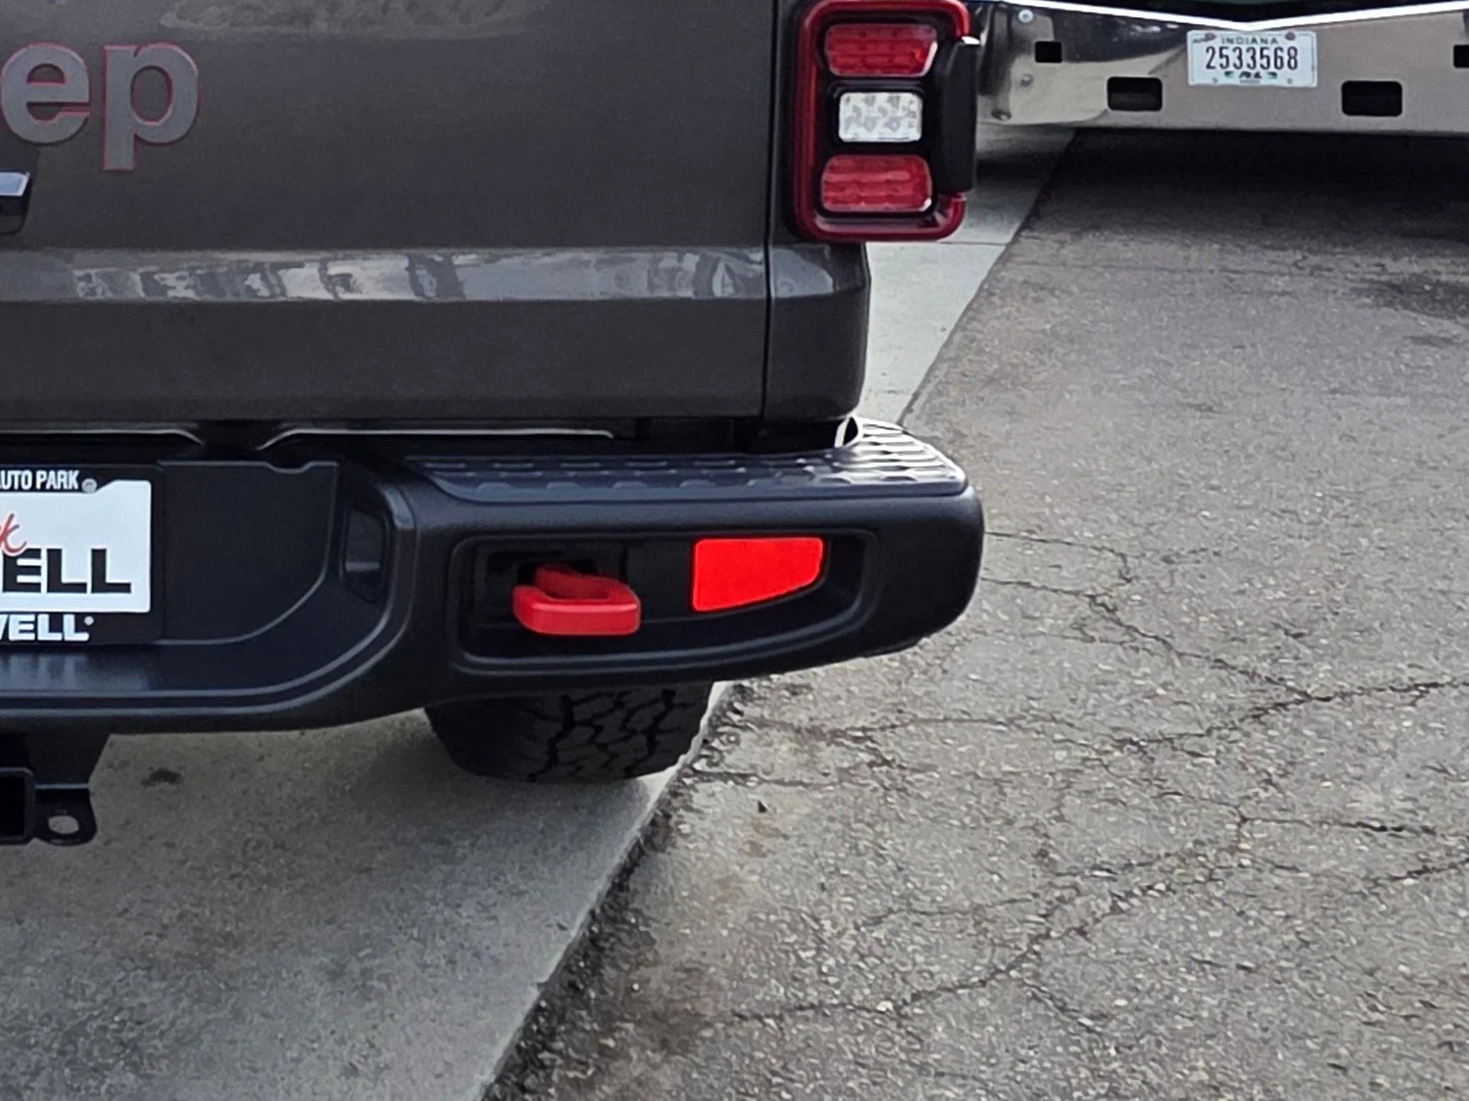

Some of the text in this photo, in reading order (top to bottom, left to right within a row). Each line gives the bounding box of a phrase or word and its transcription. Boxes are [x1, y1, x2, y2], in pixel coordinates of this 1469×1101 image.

[1221, 36, 1279, 45] INDIANA
[1205, 46, 1298, 70] 2533568
[36, 470, 80, 490] PARK
